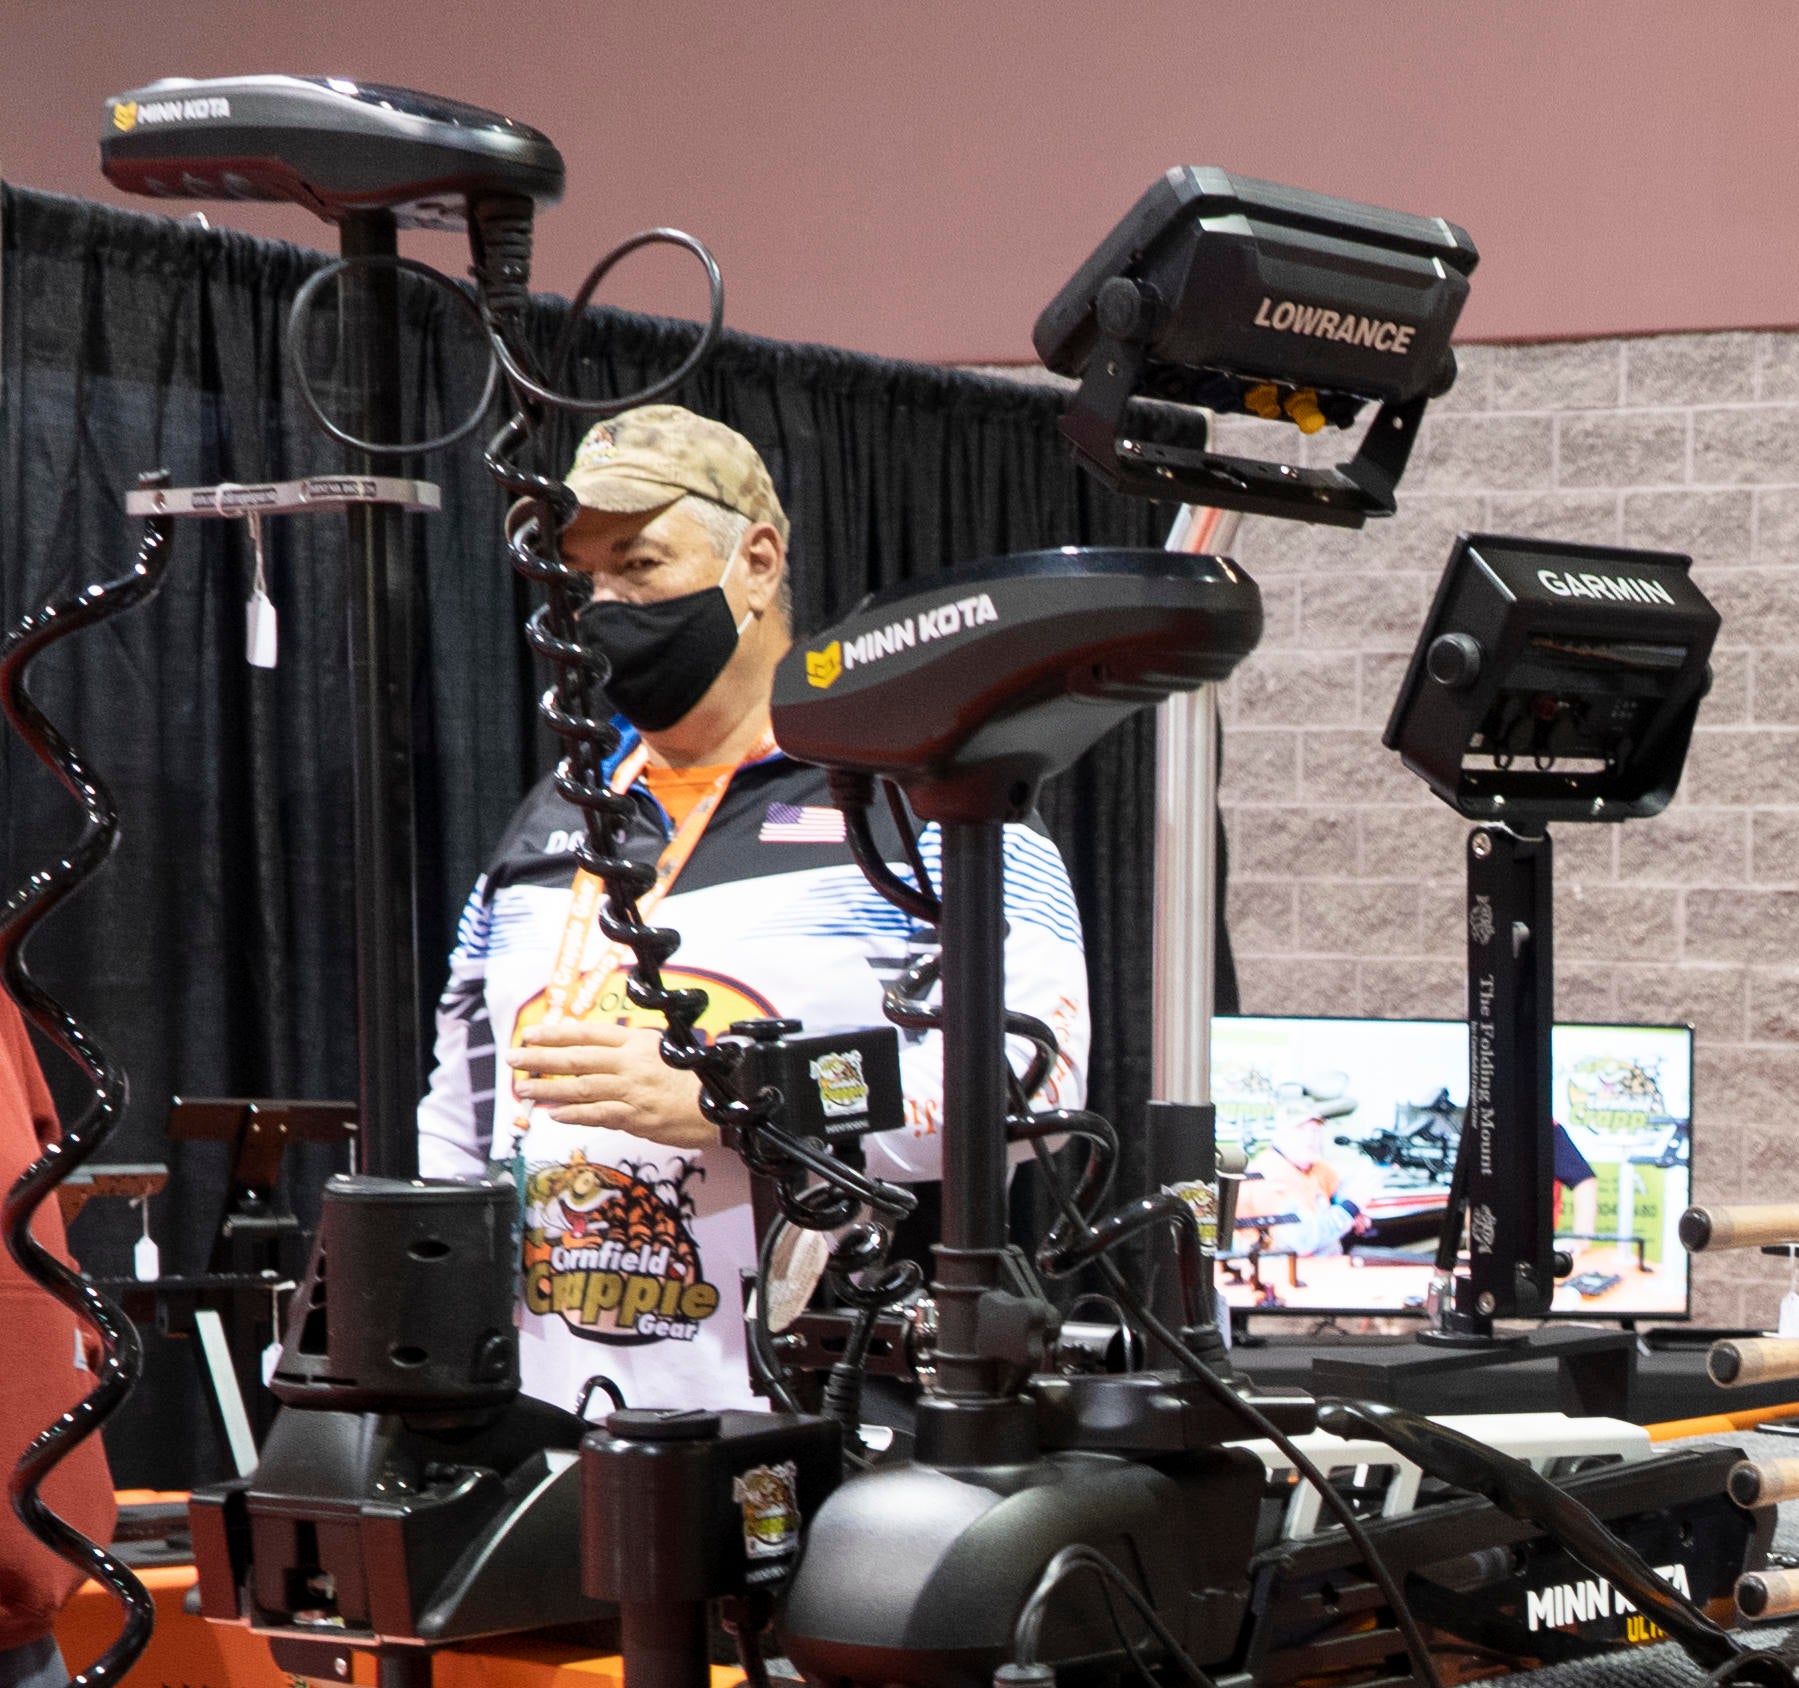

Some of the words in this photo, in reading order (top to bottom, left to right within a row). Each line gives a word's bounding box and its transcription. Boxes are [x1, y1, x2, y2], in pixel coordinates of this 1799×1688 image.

[137, 101, 183, 124] MINN
[183, 97, 231, 120] KOTA
[1253, 296, 1415, 355] LOWRANCE
[1536, 568, 1675, 605] GARMIN
[842, 620, 916, 670] MINN
[919, 592, 998, 645] KOTA
[1480, 974, 1495, 1018] The
[1477, 1021, 1495, 1103] Folding
[1479, 1106, 1495, 1177] Mount
[636, 1313, 699, 1341] Gear
[1526, 1577, 1610, 1632] MINN
